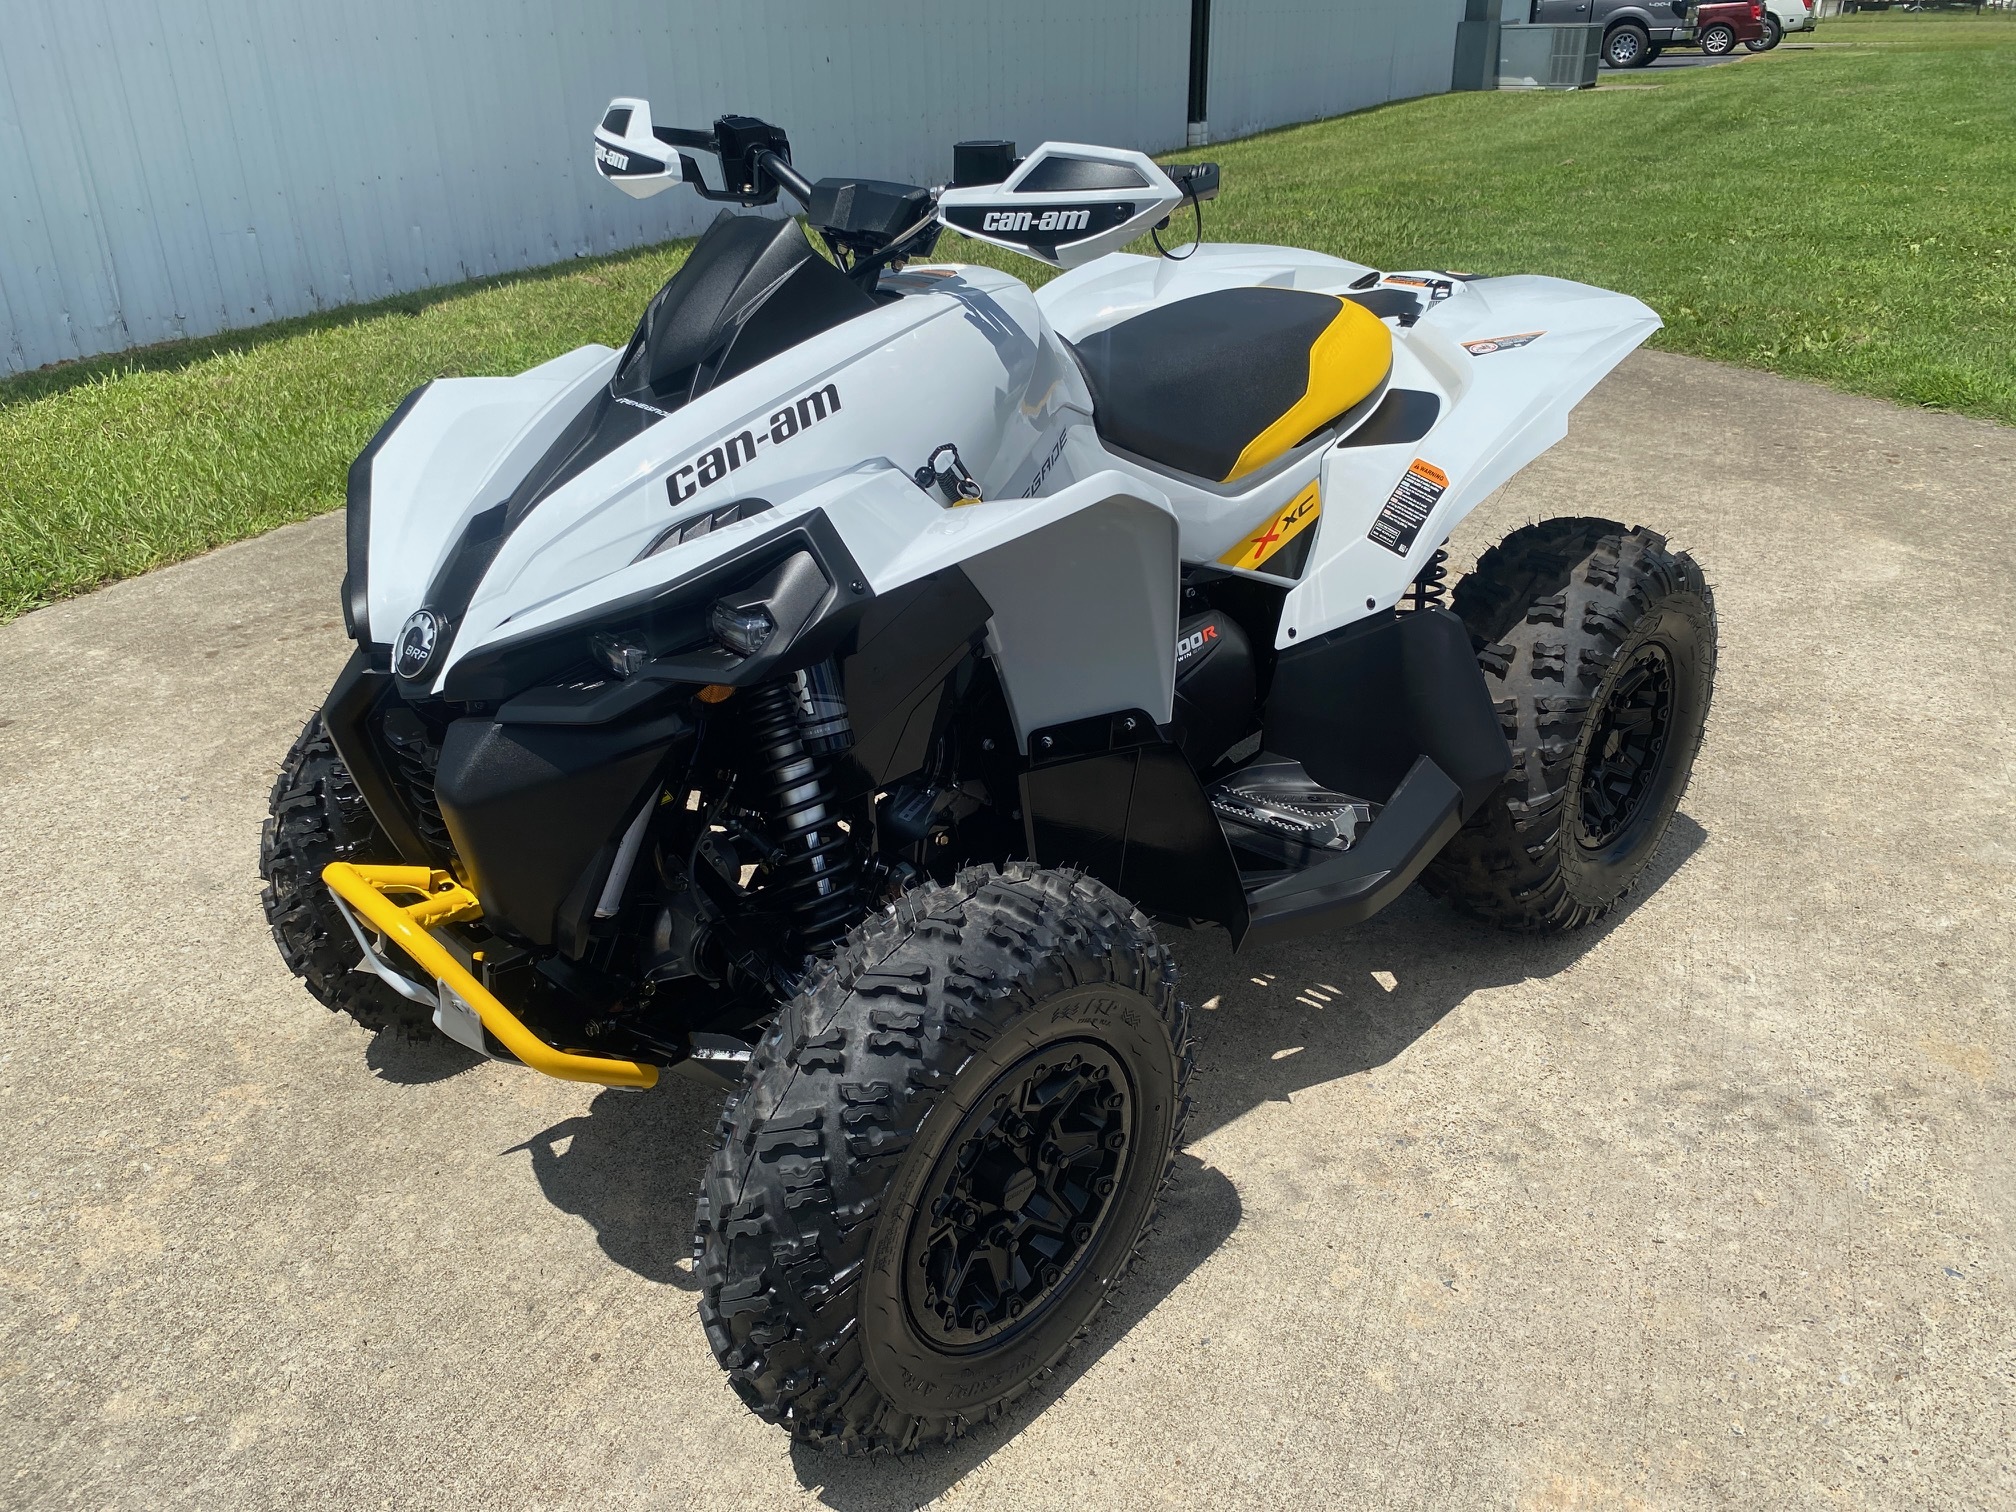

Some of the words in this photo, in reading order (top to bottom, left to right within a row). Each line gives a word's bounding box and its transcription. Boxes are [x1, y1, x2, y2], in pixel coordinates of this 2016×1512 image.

[595, 141, 629, 171] an-am
[983, 210, 1091, 231] can-am
[665, 383, 842, 507] can-am
[405, 644, 428, 660] BRP
[1177, 625, 1218, 656] 00R
